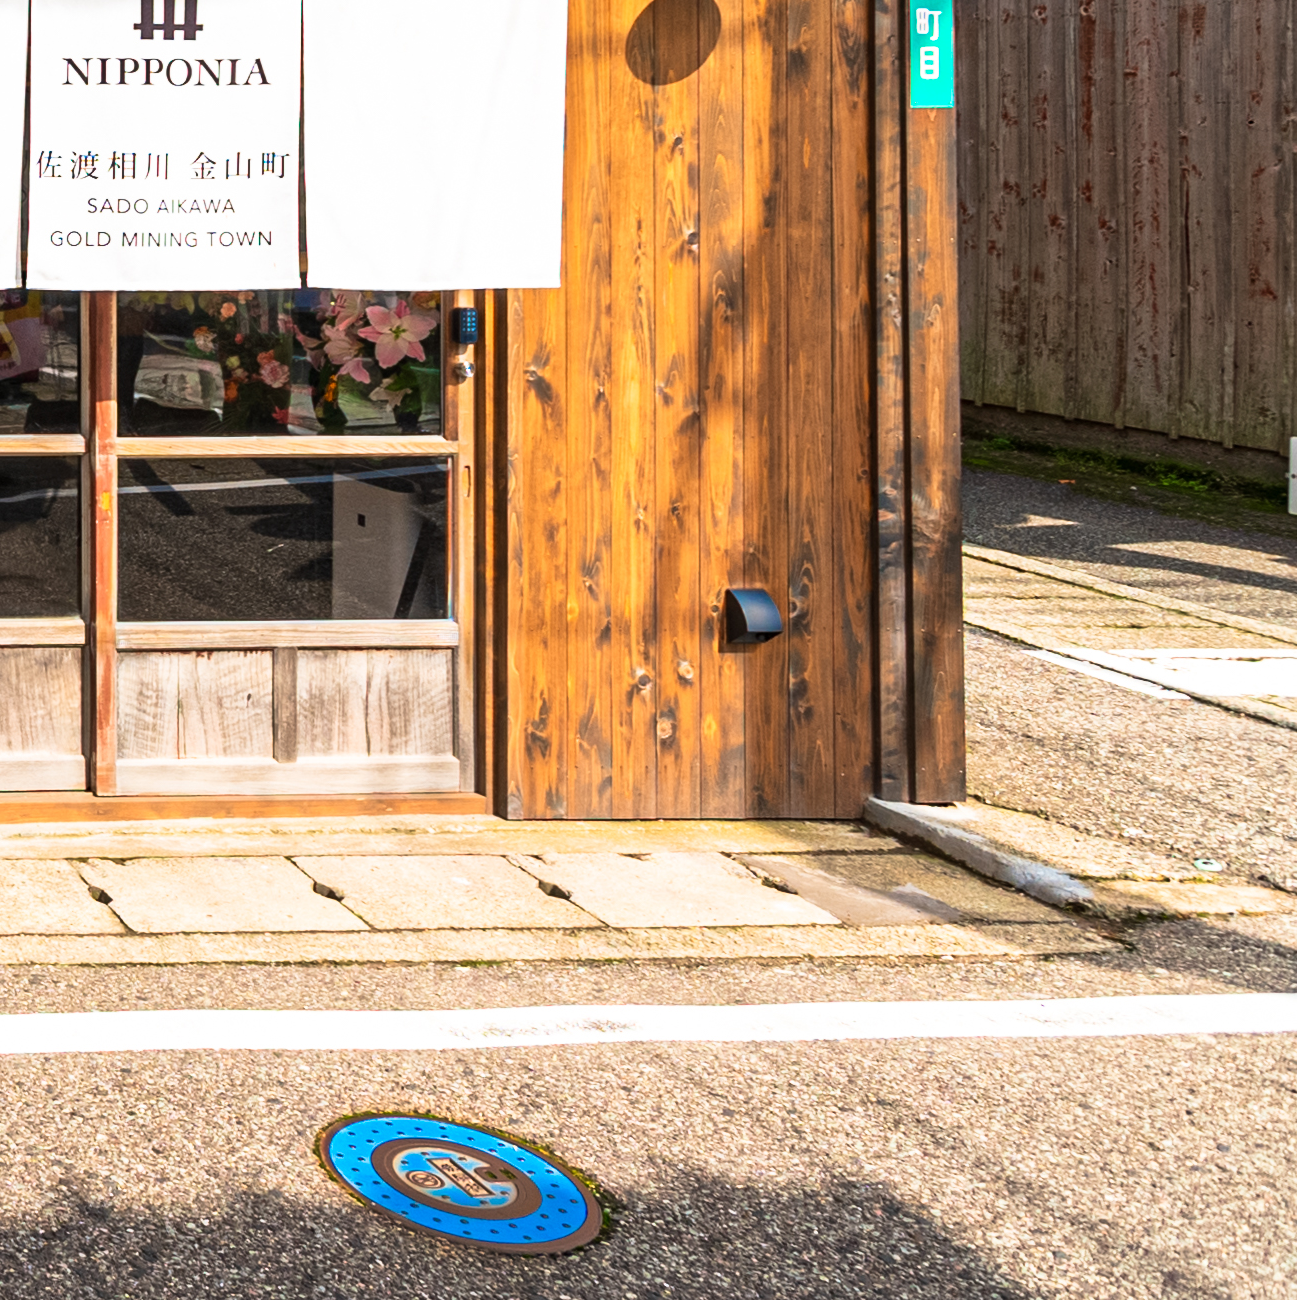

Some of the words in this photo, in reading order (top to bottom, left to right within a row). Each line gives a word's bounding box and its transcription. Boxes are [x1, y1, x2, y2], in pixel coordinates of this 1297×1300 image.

[61, 57, 272, 87] NIPPONIA
[35, 150, 170, 181] 佐渡相川
[189, 150, 291, 181] 金山町
[87, 197, 149, 215] SADO
[156, 197, 236, 215] AIKAWA
[50, 230, 112, 248] GOLD
[121, 230, 199, 248] MINING
[206, 230, 273, 247] TOWN
